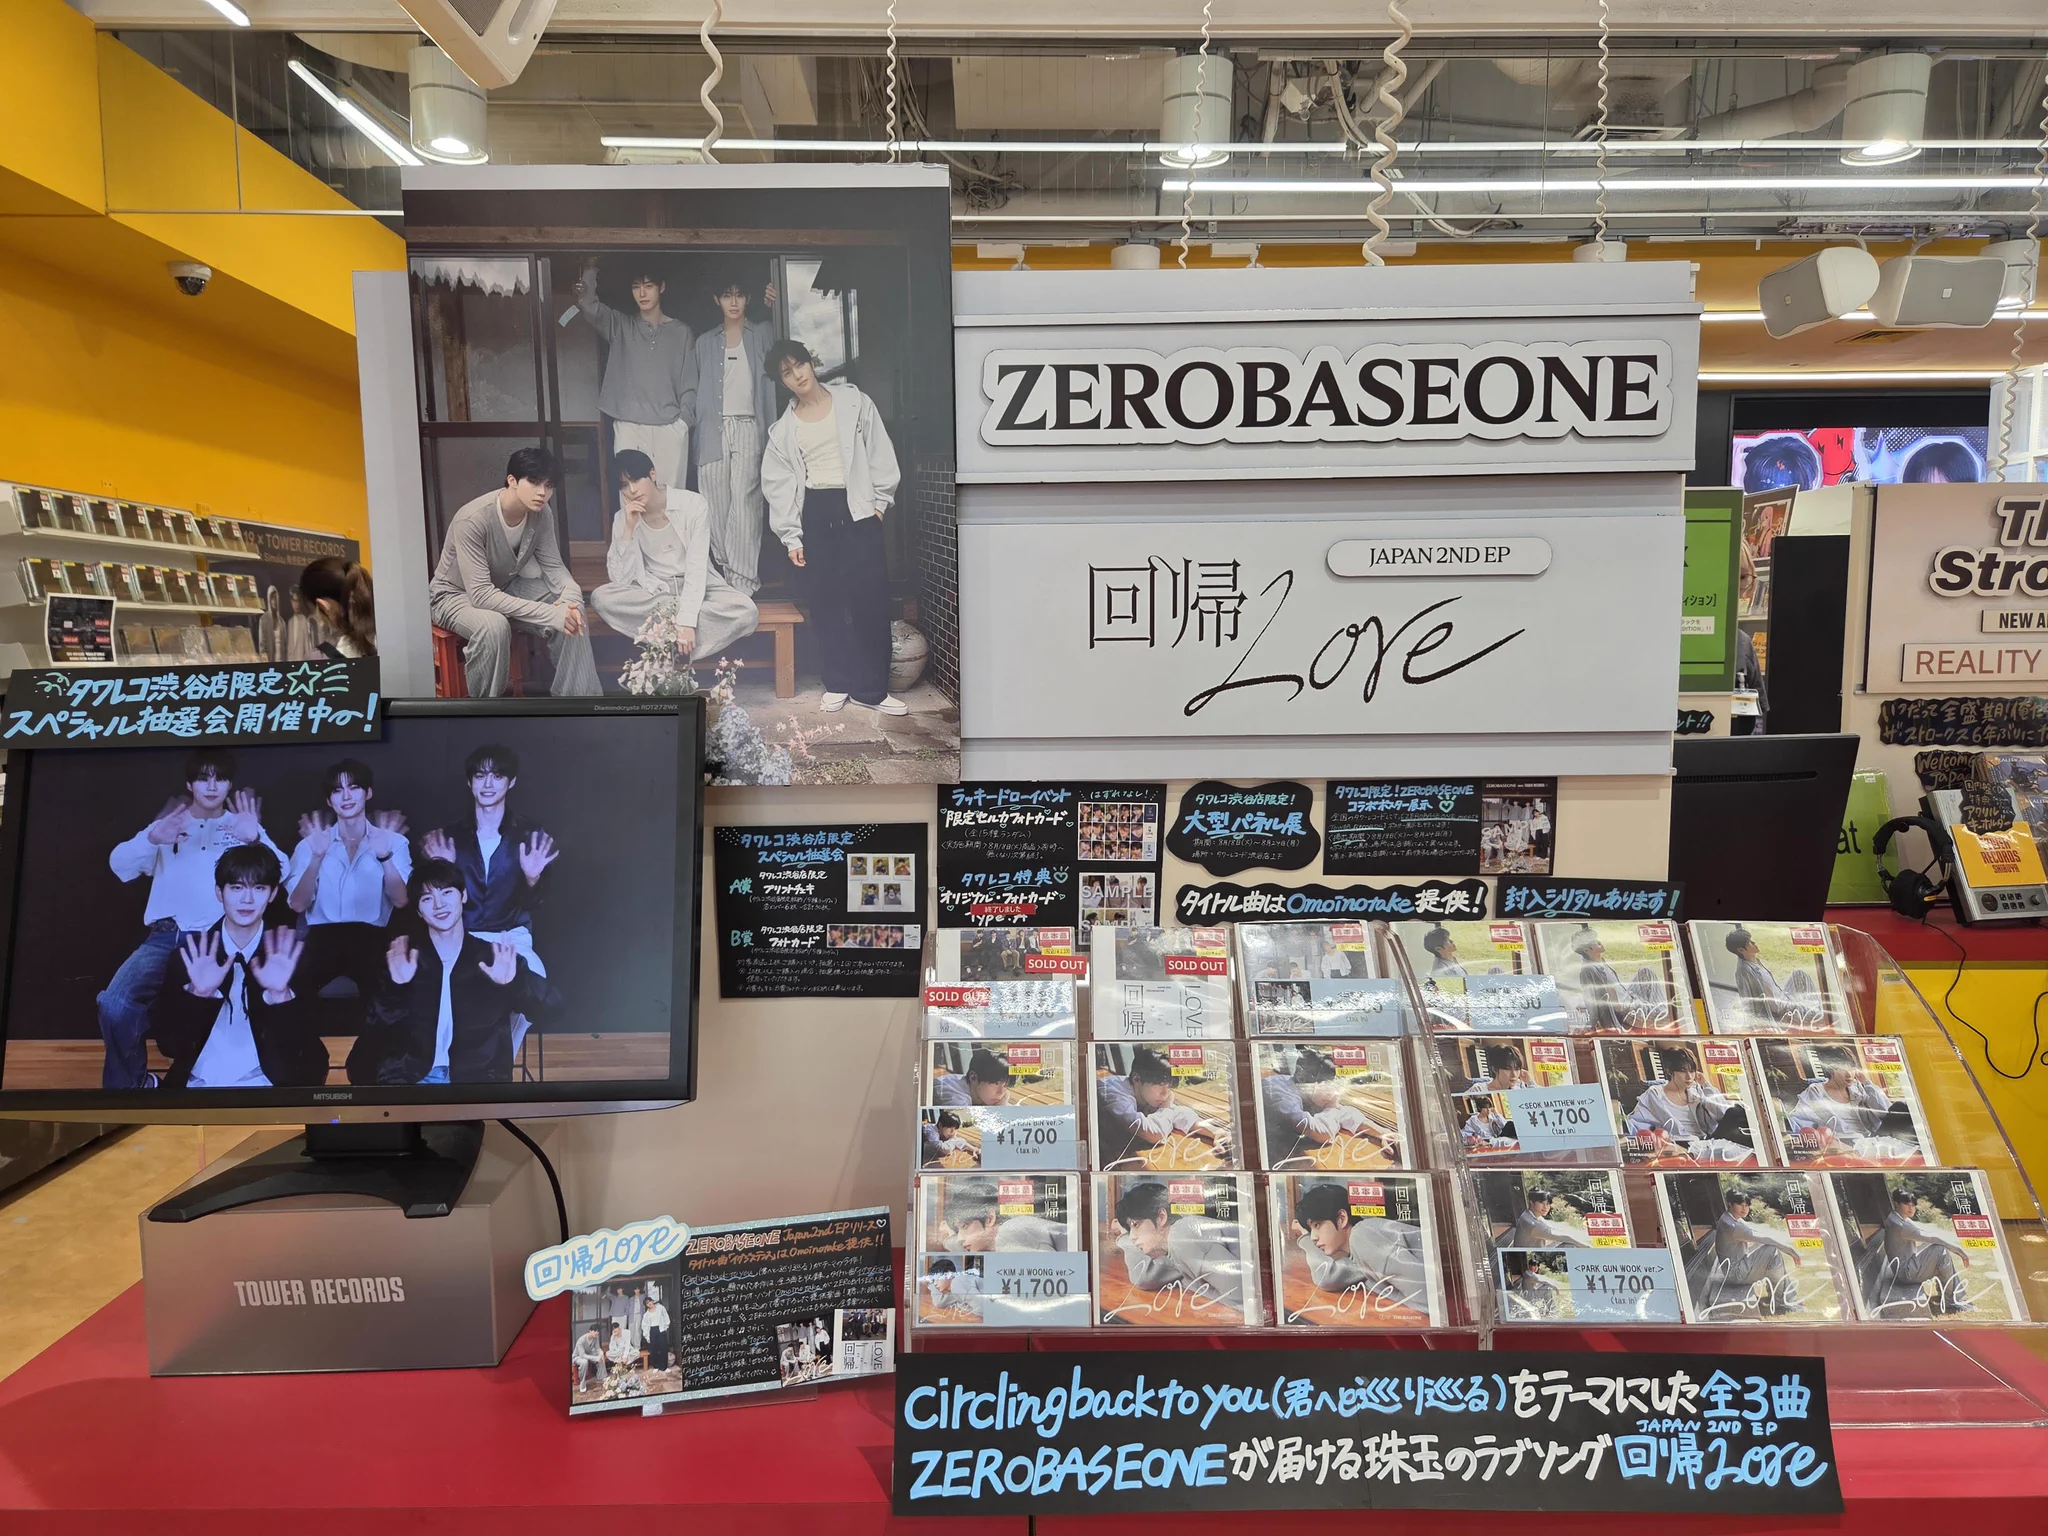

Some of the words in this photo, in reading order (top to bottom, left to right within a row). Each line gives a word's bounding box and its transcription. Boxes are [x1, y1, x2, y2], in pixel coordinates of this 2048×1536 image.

[996, 353, 1659, 432] ZEROBASEONE
[266, 533, 301, 551] TOWER
[303, 539, 347, 557] RECORDS
[1368, 546, 1434, 568] JAPAN
[1435, 546, 1481, 564] 2ND
[1483, 546, 1512, 564] EP
[1935, 550, 2048, 591] Stro
[1999, 611, 2034, 630] NEW
[2036, 611, 2048, 630] A
[1915, 649, 2042, 676] REALITY
[67, 668, 285, 707] タワレコ渋谷店限定
[951, 788, 1072, 806] ラッキードローイベント
[1195, 793, 1296, 806] タワレコ渋谷店限定!
[1347, 799, 1434, 813] コラボポスター展示
[945, 810, 1069, 828] 限定セルカフォトカード
[1182, 809, 1307, 836] 大型パネル展
[740, 831, 854, 848] タワレコ渋谷店限定
[758, 848, 845, 864] スペシャル抽選会
[1979, 850, 2022, 865] RECORDS
[758, 869, 828, 880] タワレコ渋谷店限定
[961, 867, 1054, 887] タワレコ特典
[1993, 864, 2021, 874] SHIBUYA
[729, 877, 753, 895] A賞
[1081, 885, 1154, 900] SAMPLE
[984, 905, 1022, 914] 終了しました
[1505, 885, 1681, 917] 封入シリアルあります!
[730, 929, 754, 948] B賞
[761, 924, 825, 935] タワレコ渋谷店限定
[769, 935, 820, 948] フォトカード
[1028, 959, 1058, 970] SOLD
[1060, 959, 1084, 970] OUT
[1168, 960, 1198, 971] SOLD
[1200, 961, 1225, 971] OUT
[929, 991, 959, 1002] SOLD
[1122, 984, 1146, 1036] 回帰
[1184, 986, 1203, 1038] LOVE
[1518, 1102, 1542, 1111] <SEOK
[1543, 1100, 1574, 1110] MATTHEW
[1574, 1098, 1595, 1107] ver.>
[1527, 1107, 1591, 1128] ¥1,700
[997, 1128, 1058, 1146] ¥1,700
[1551, 1127, 1567, 1136] (tax
[1568, 1126, 1577, 1135] in)
[1015, 1146, 1031, 1155] (tax
[1032, 1146, 1041, 1155] in)
[1103, 1118, 1235, 1172] Love
[1626, 1135, 1655, 1151] 回帰
[1790, 1132, 1819, 1150] 回帰
[1044, 1183, 1060, 1219] 回帰
[1215, 1184, 1230, 1219] 回帰
[1395, 1185, 1411, 1221] 回帰
[1786, 1180, 1806, 1214] 回帰
[1951, 1181, 1971, 1215] 回帰
[686, 1230, 781, 1256] ZEROBASEONE
[996, 1268, 1017, 1276] <KIM
[1018, 1268, 1025, 1276] JI
[1026, 1268, 1054, 1276] WOONG
[1055, 1268, 1075, 1277] ver.>
[1574, 1264, 1601, 1273] <PARK
[1602, 1265, 1618, 1273] GUN
[1620, 1265, 1642, 1273] WOOK
[1643, 1265, 1665, 1274] ver.>
[233, 1279, 307, 1308] TOWER
[311, 1276, 405, 1305] RECORDS
[1001, 1278, 1068, 1298] ¥1,700
[1103, 1260, 1238, 1323] Love
[1288, 1261, 1423, 1323] Love
[1585, 1274, 1654, 1295] ¥1,700
[1699, 1257, 1830, 1320] Love
[1870, 1256, 1999, 1320] Love
[1610, 1296, 1627, 1305] (tax
[873, 1341, 884, 1371] LOVE
[1636, 1419, 1701, 1434] JAPAN
[1706, 1419, 1740, 1435] 2ND
[1751, 1420, 1779, 1437] EP
